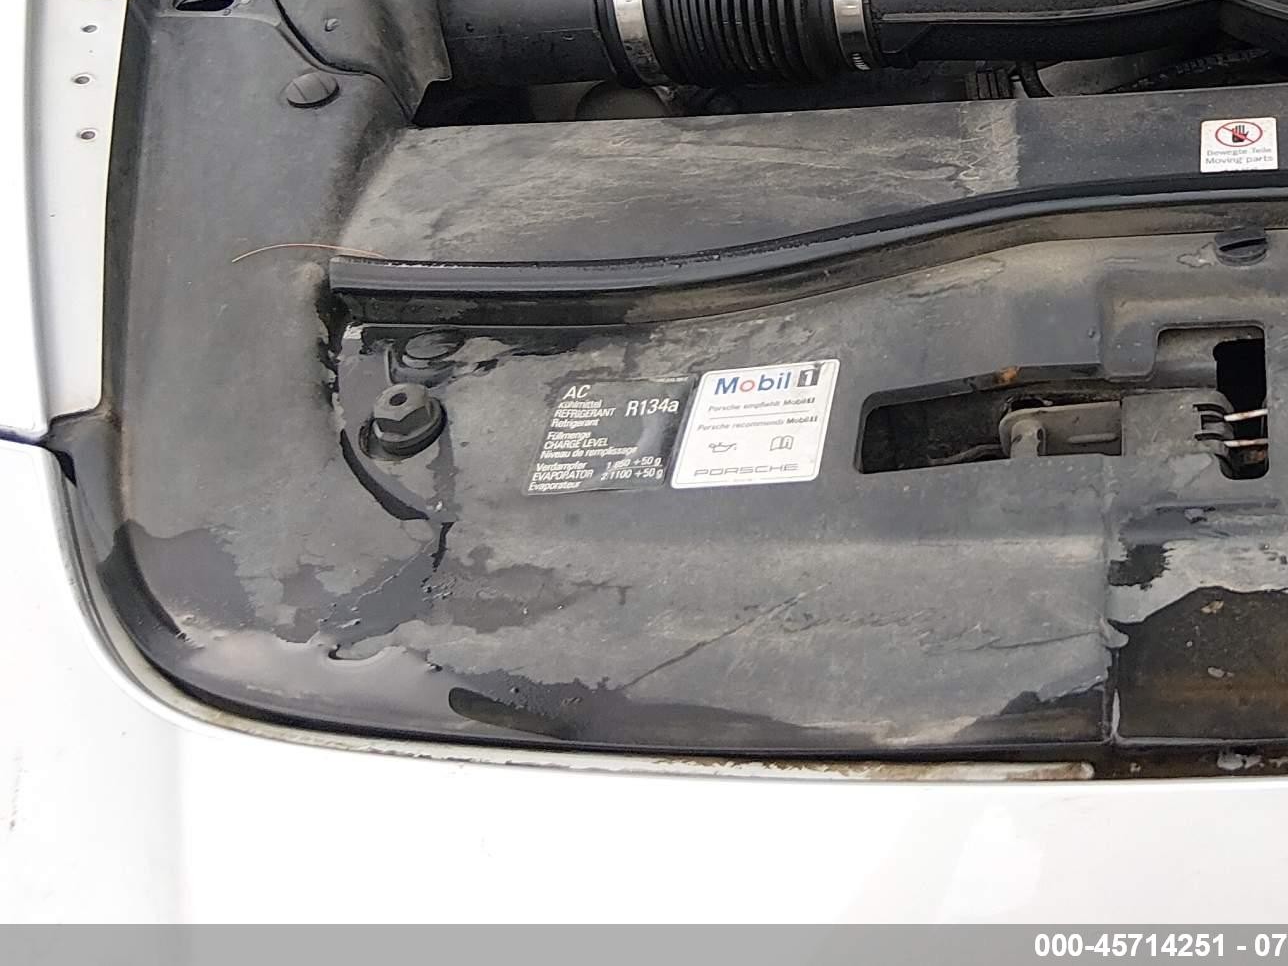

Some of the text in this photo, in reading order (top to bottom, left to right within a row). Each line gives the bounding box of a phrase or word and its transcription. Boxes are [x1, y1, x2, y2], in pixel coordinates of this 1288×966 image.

[715, 372, 792, 395] Mobil
[562, 385, 590, 400] AC
[554, 398, 680, 418] REFRIGERANT R134a
[544, 438, 609, 450] CHARGE LEVEL
[540, 450, 572, 460] Niveau
[572, 448, 584, 458] de
[536, 461, 588, 472] Verdampfer
[694, 462, 800, 477] PORSCHE
[532, 470, 594, 482] EVAPORATOR
[528, 482, 582, 492] Evaporateur
